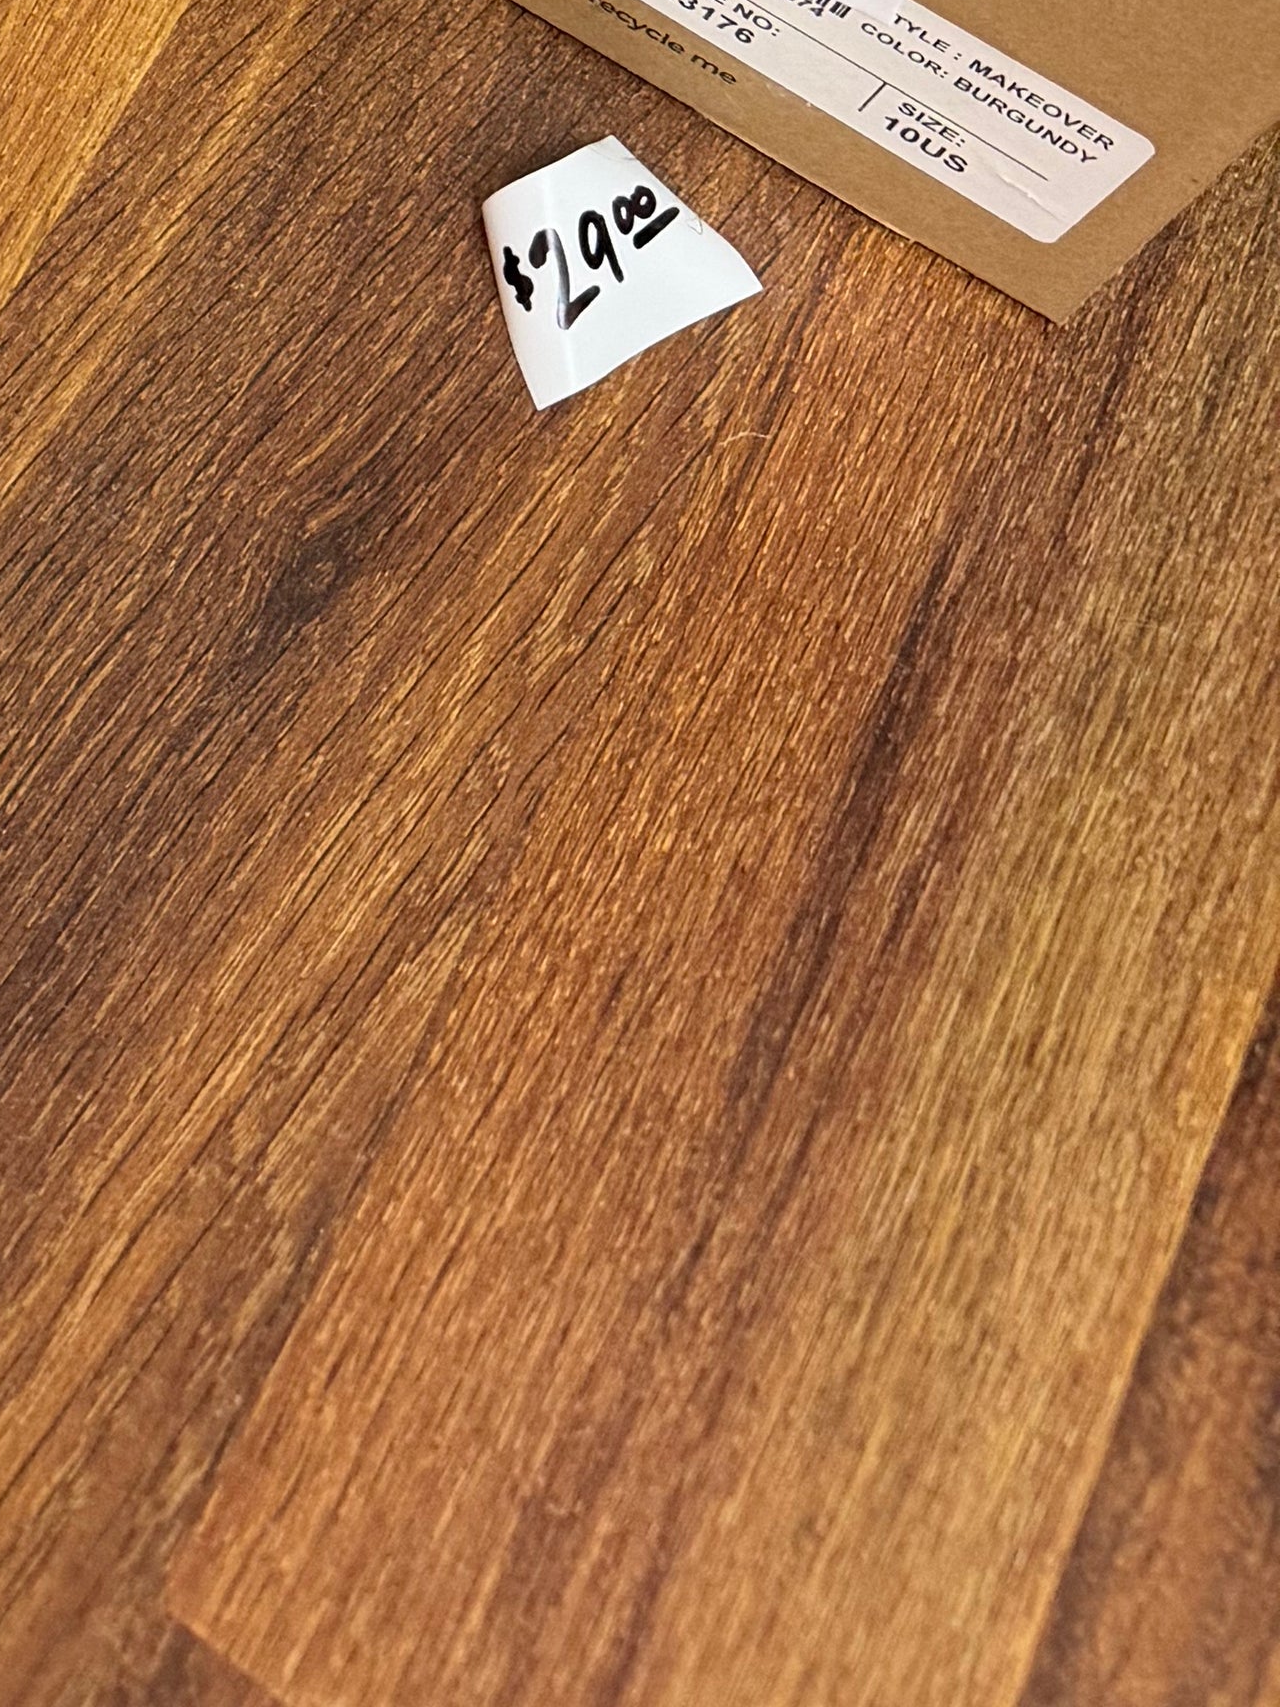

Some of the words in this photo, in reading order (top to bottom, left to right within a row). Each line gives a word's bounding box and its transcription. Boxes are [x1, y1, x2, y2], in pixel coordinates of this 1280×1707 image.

[733, 2, 782, 39] NO:
[690, 52, 738, 85] me
[860, 20, 951, 80] COLOR:
[954, 76, 1099, 167] BURGUNDY
[897, 100, 969, 148] SIZE:
[969, 58, 1116, 153] MAKEOVER
[882, 116, 970, 176] 10US
